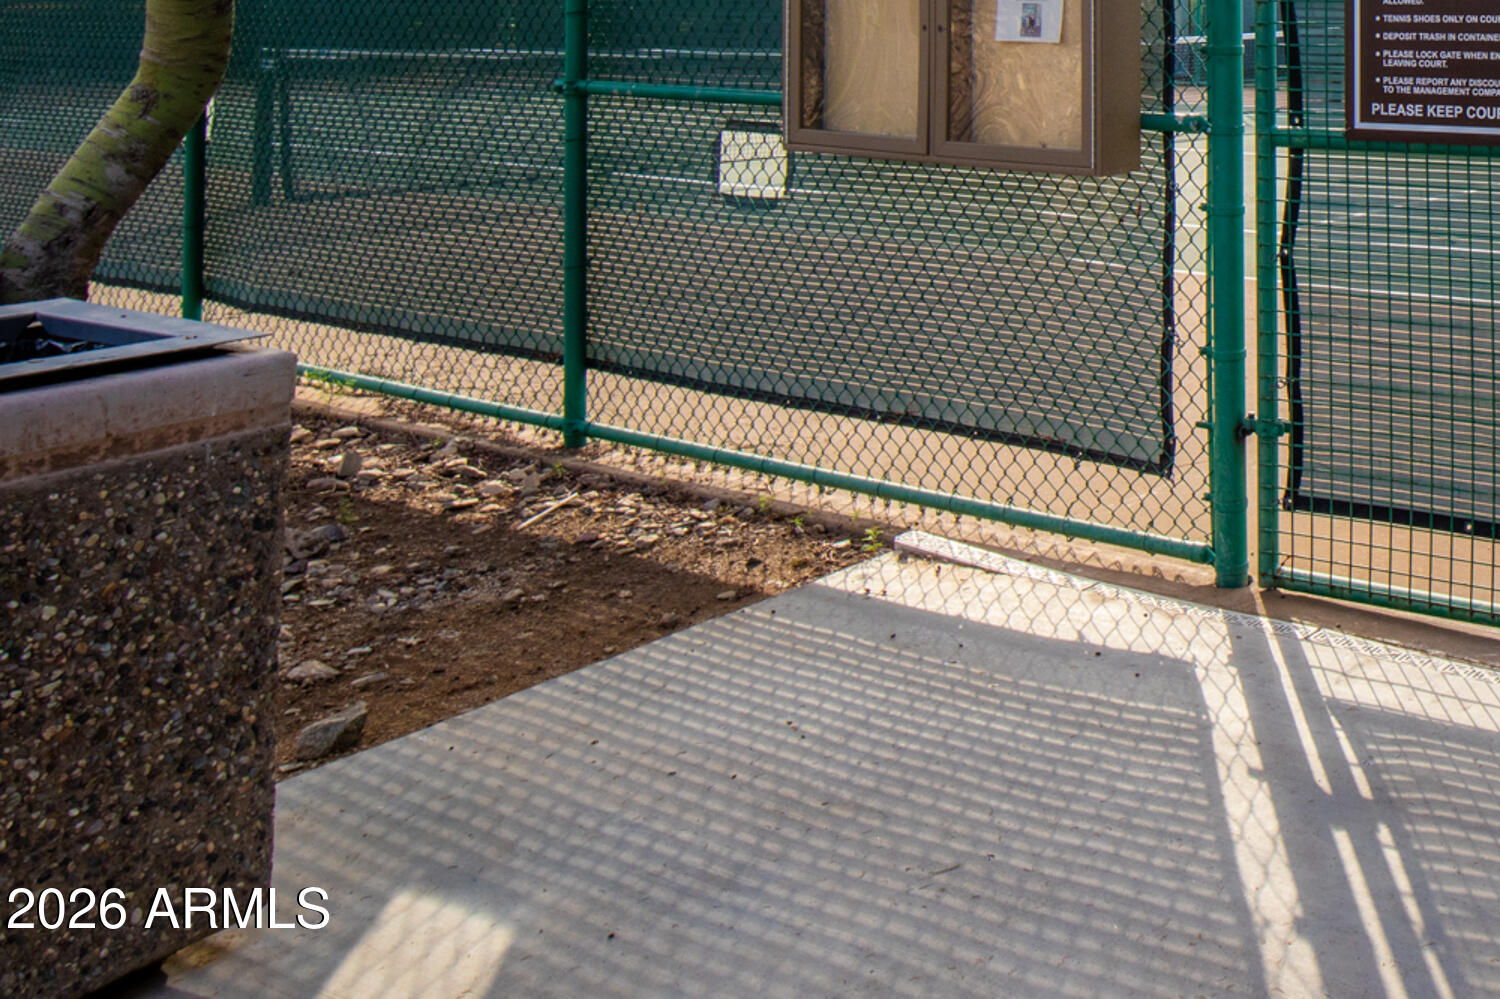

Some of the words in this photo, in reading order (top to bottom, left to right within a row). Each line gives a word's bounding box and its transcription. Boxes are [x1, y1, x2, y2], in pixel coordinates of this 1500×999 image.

[1383, 15, 1411, 23] TENNIS
[1413, 15, 1440, 23] SHOES
[1442, 15, 1463, 23] ONLY
[1465, 15, 1478, 23] ON
[1383, 32, 1417, 40] DEPOSIT
[1419, 32, 1446, 40] TRASH
[1383, 51, 1414, 59] PLEASE
[1416, 51, 1437, 59] LOCK
[1439, 51, 1461, 60] GATE
[1463, 52, 1488, 60] WHEN
[1383, 60, 1417, 68] LEAVING
[1419, 60, 1448, 68] COURT.
[1383, 77, 1414, 85] PLEASE
[1416, 78, 1448, 86] REPORT
[1450, 78, 1467, 86] ANY
[1396, 86, 1411, 94] THE
[1413, 86, 1470, 96] MANAGEMENT
[1371, 103, 1423, 116] PLEASE
[1427, 105, 1463, 118] KEEP
